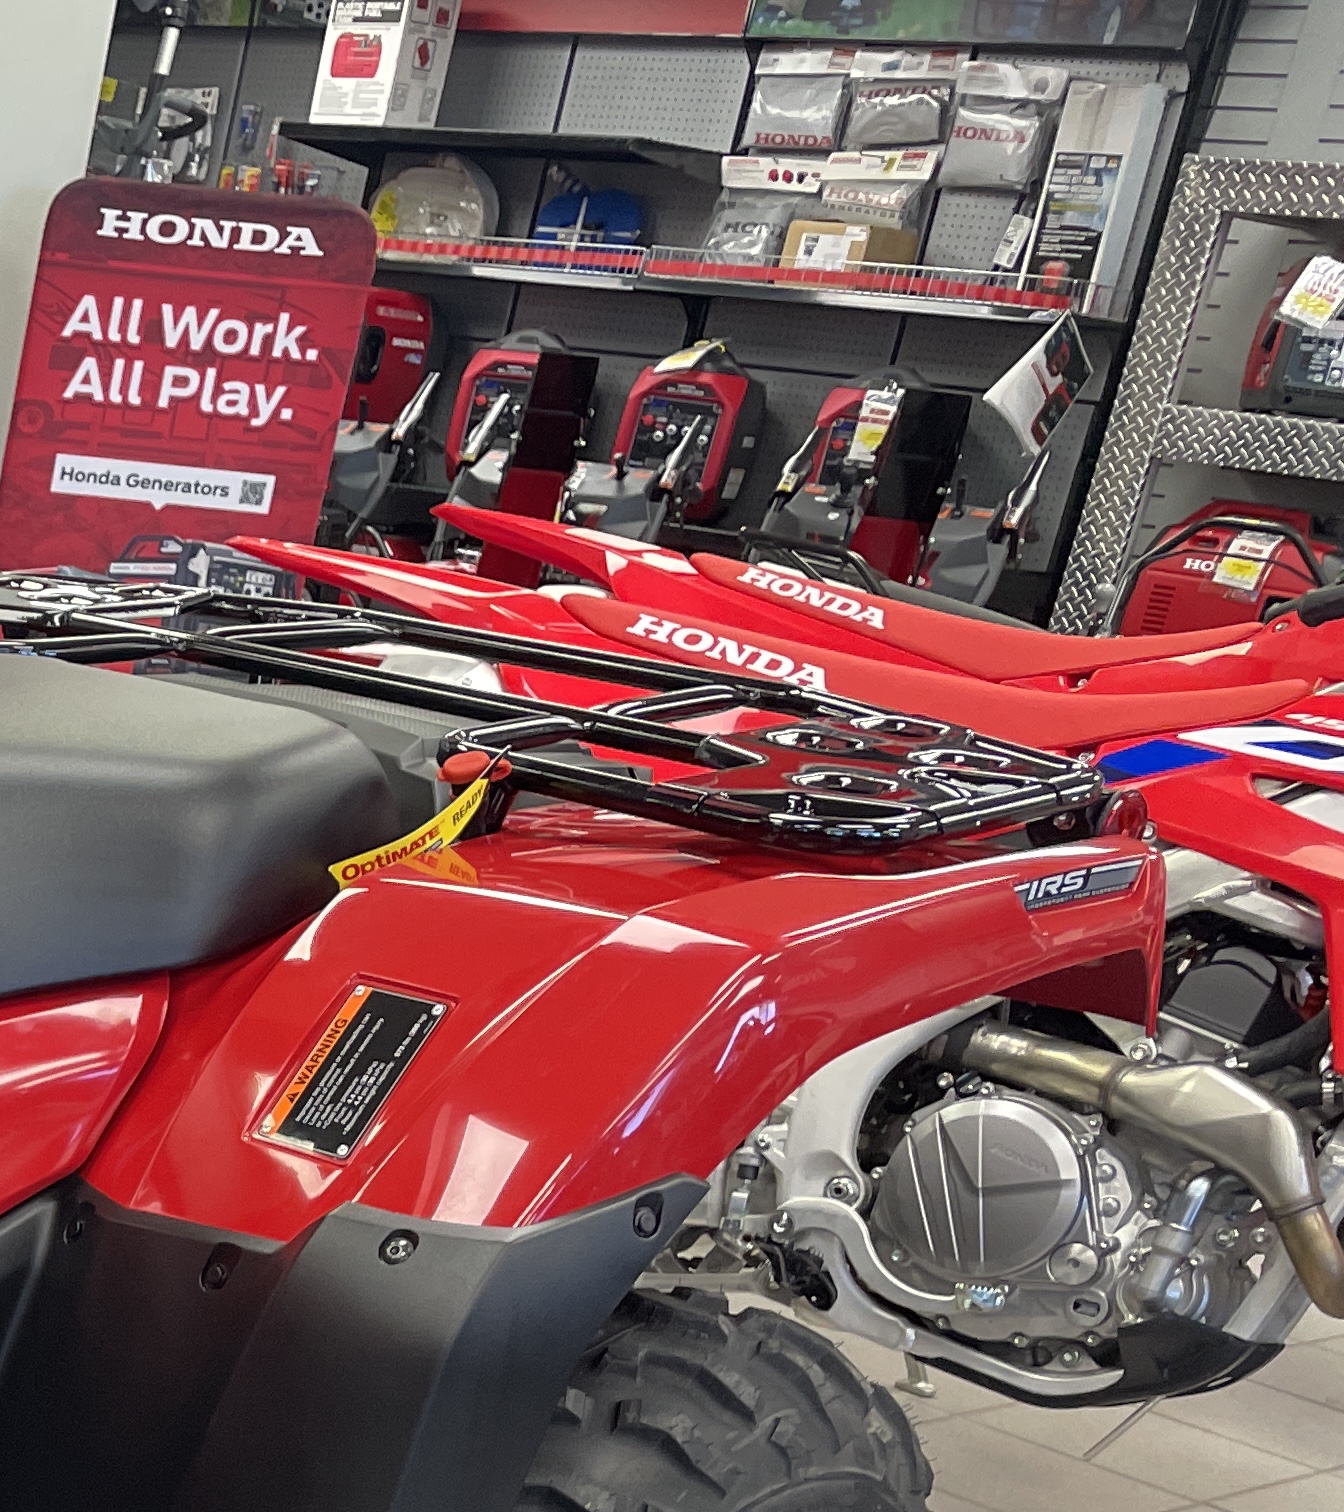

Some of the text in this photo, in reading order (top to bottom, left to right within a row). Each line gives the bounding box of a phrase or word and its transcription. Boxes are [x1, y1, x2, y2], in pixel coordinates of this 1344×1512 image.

[754, 133, 833, 147] HONDA
[96, 207, 324, 256] HONDA
[61, 295, 319, 361] All Work.
[63, 356, 293, 427] All Play.
[60, 466, 230, 497] Honda Generators
[736, 567, 885, 629] HONDA
[626, 614, 828, 692] HONDA
[452, 785, 485, 827] READY
[1028, 869, 1087, 900] IRS
[293, 1017, 349, 1092] WARNING
